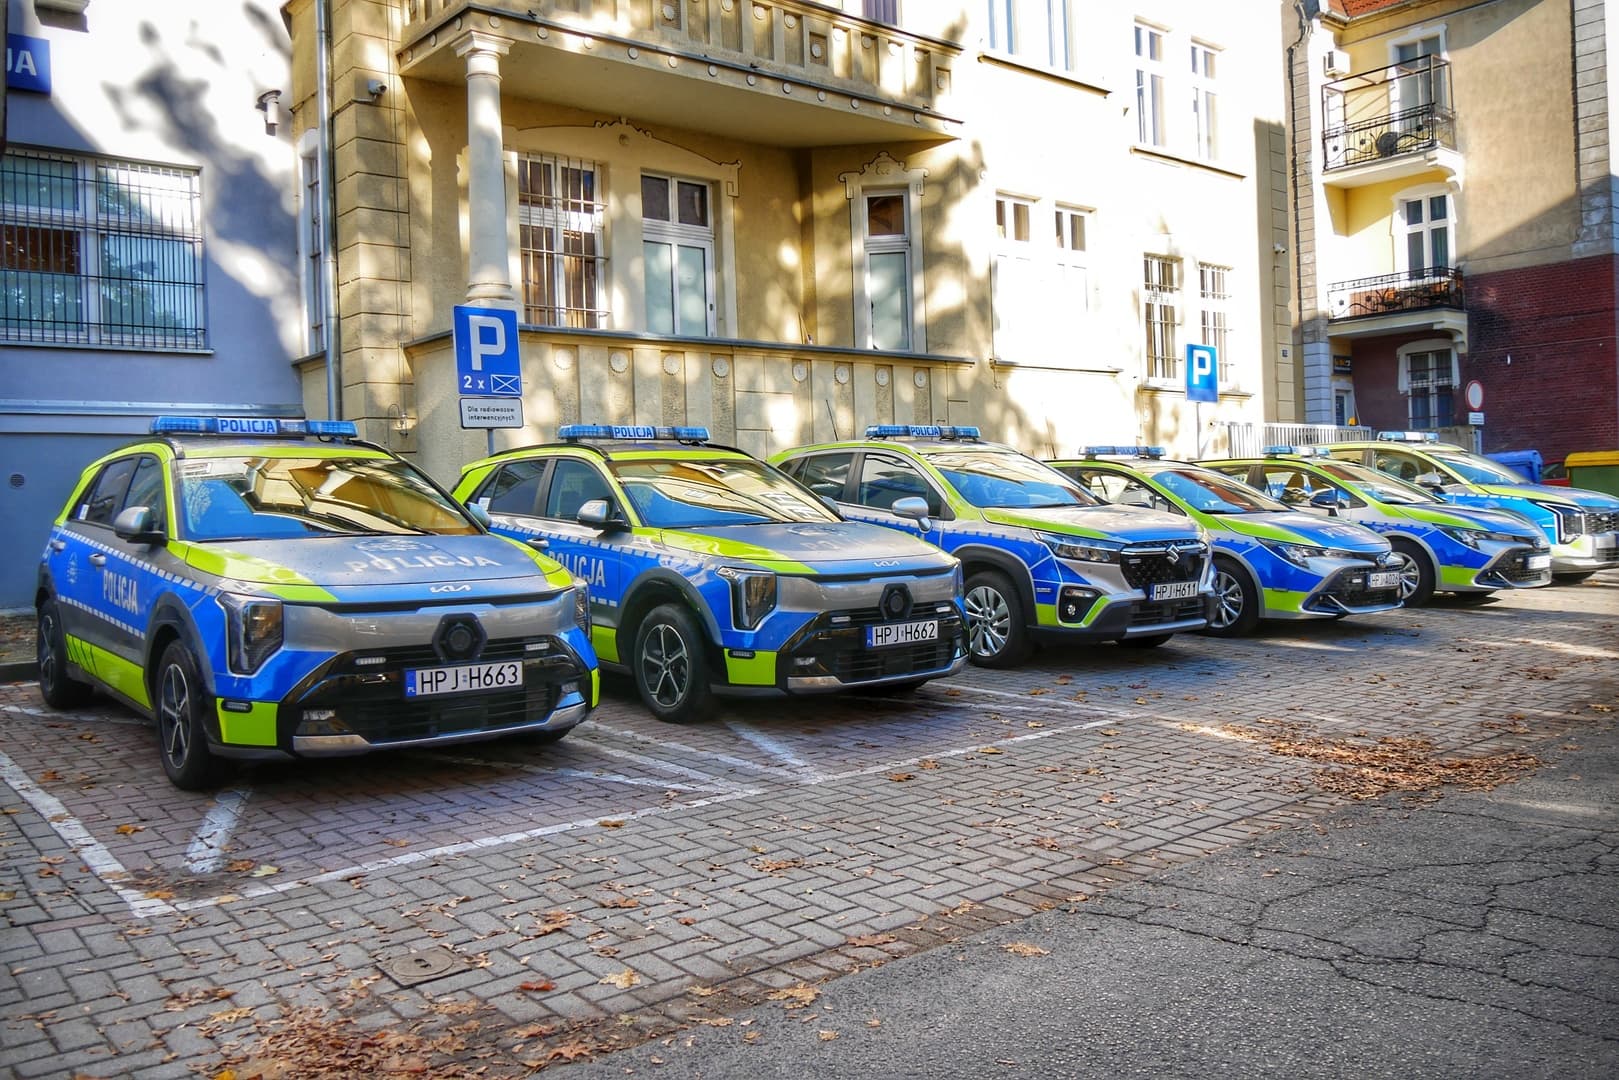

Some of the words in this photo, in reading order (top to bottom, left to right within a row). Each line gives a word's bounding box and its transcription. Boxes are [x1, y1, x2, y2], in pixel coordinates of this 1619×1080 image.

[468, 315, 506, 371] P
[1193, 349, 1211, 385] P
[463, 375, 473, 389] 2
[219, 419, 276, 433] POLICJA
[613, 427, 653, 437] POLICJA
[910, 426, 939, 436] POLICJA
[344, 555, 503, 573] POLICJA
[103, 569, 138, 616] POLICJA
[875, 626, 899, 644] HPJ
[905, 622, 935, 640] H662
[421, 670, 459, 693] HPJ
[469, 664, 518, 688] H663
